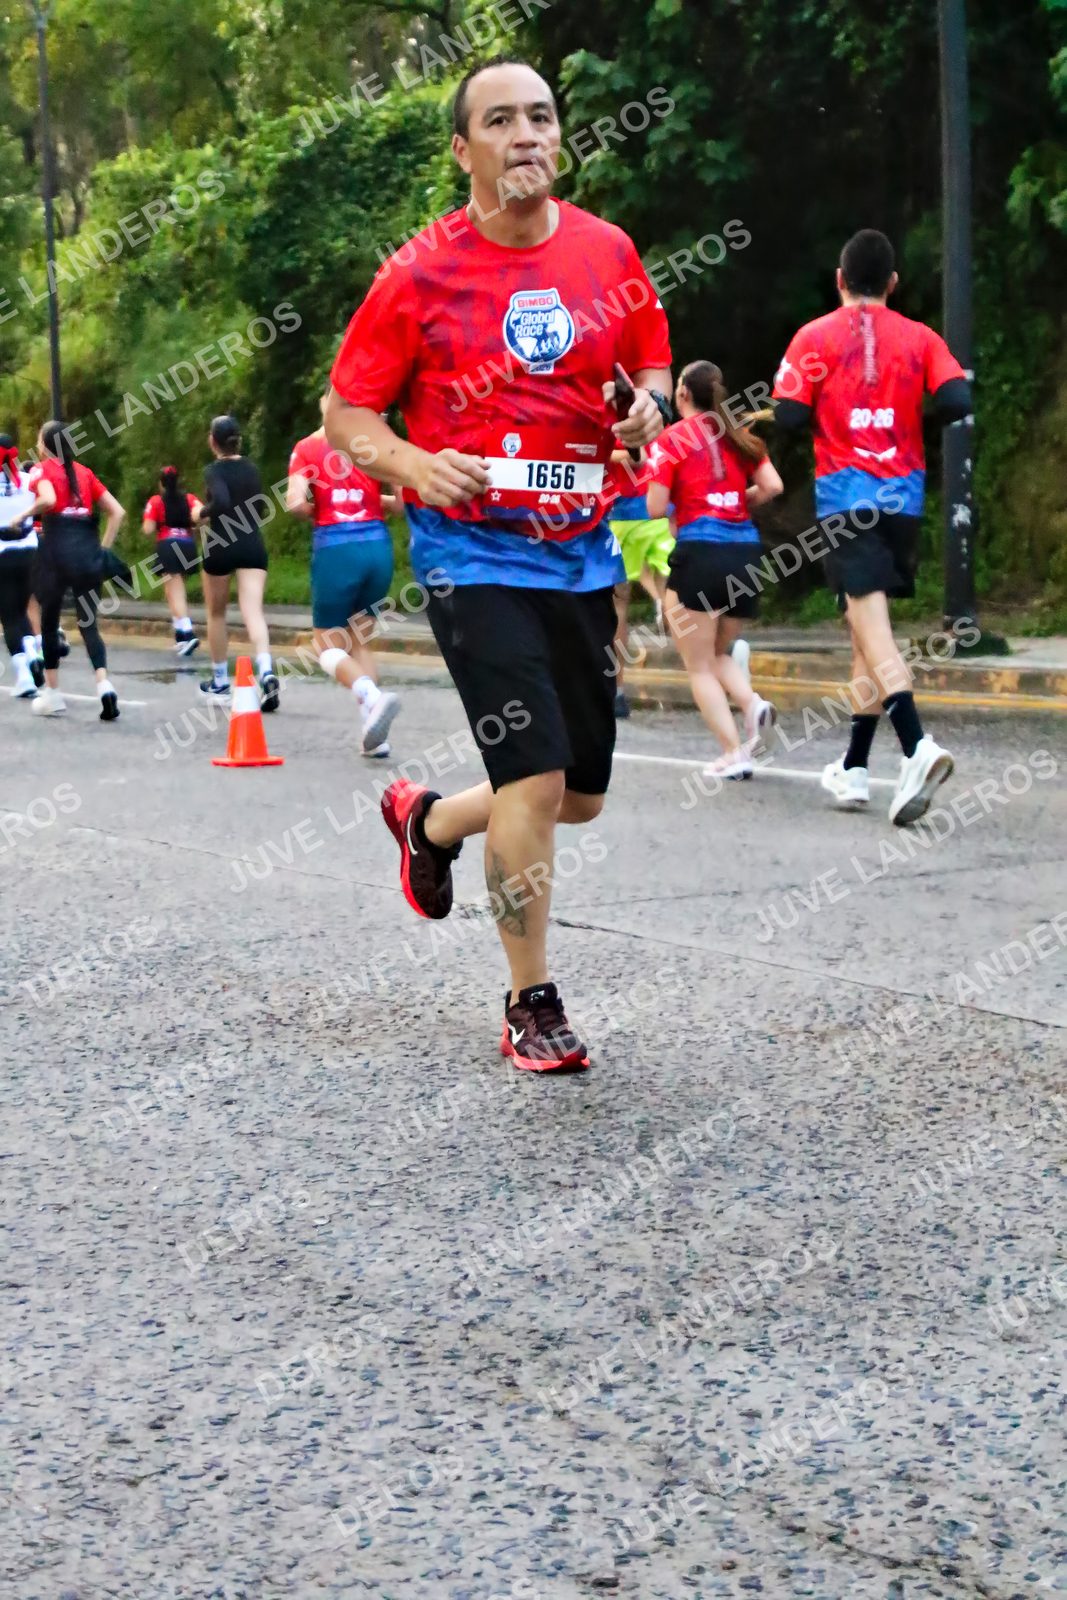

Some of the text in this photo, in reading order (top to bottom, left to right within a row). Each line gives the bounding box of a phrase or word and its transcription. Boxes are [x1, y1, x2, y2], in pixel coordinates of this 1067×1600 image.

[517, 296, 554, 308] BIMBO
[520, 311, 555, 325] Global
[515, 324, 543, 338] Race
[850, 408, 895, 428] 20-26
[527, 462, 576, 490] 1656
